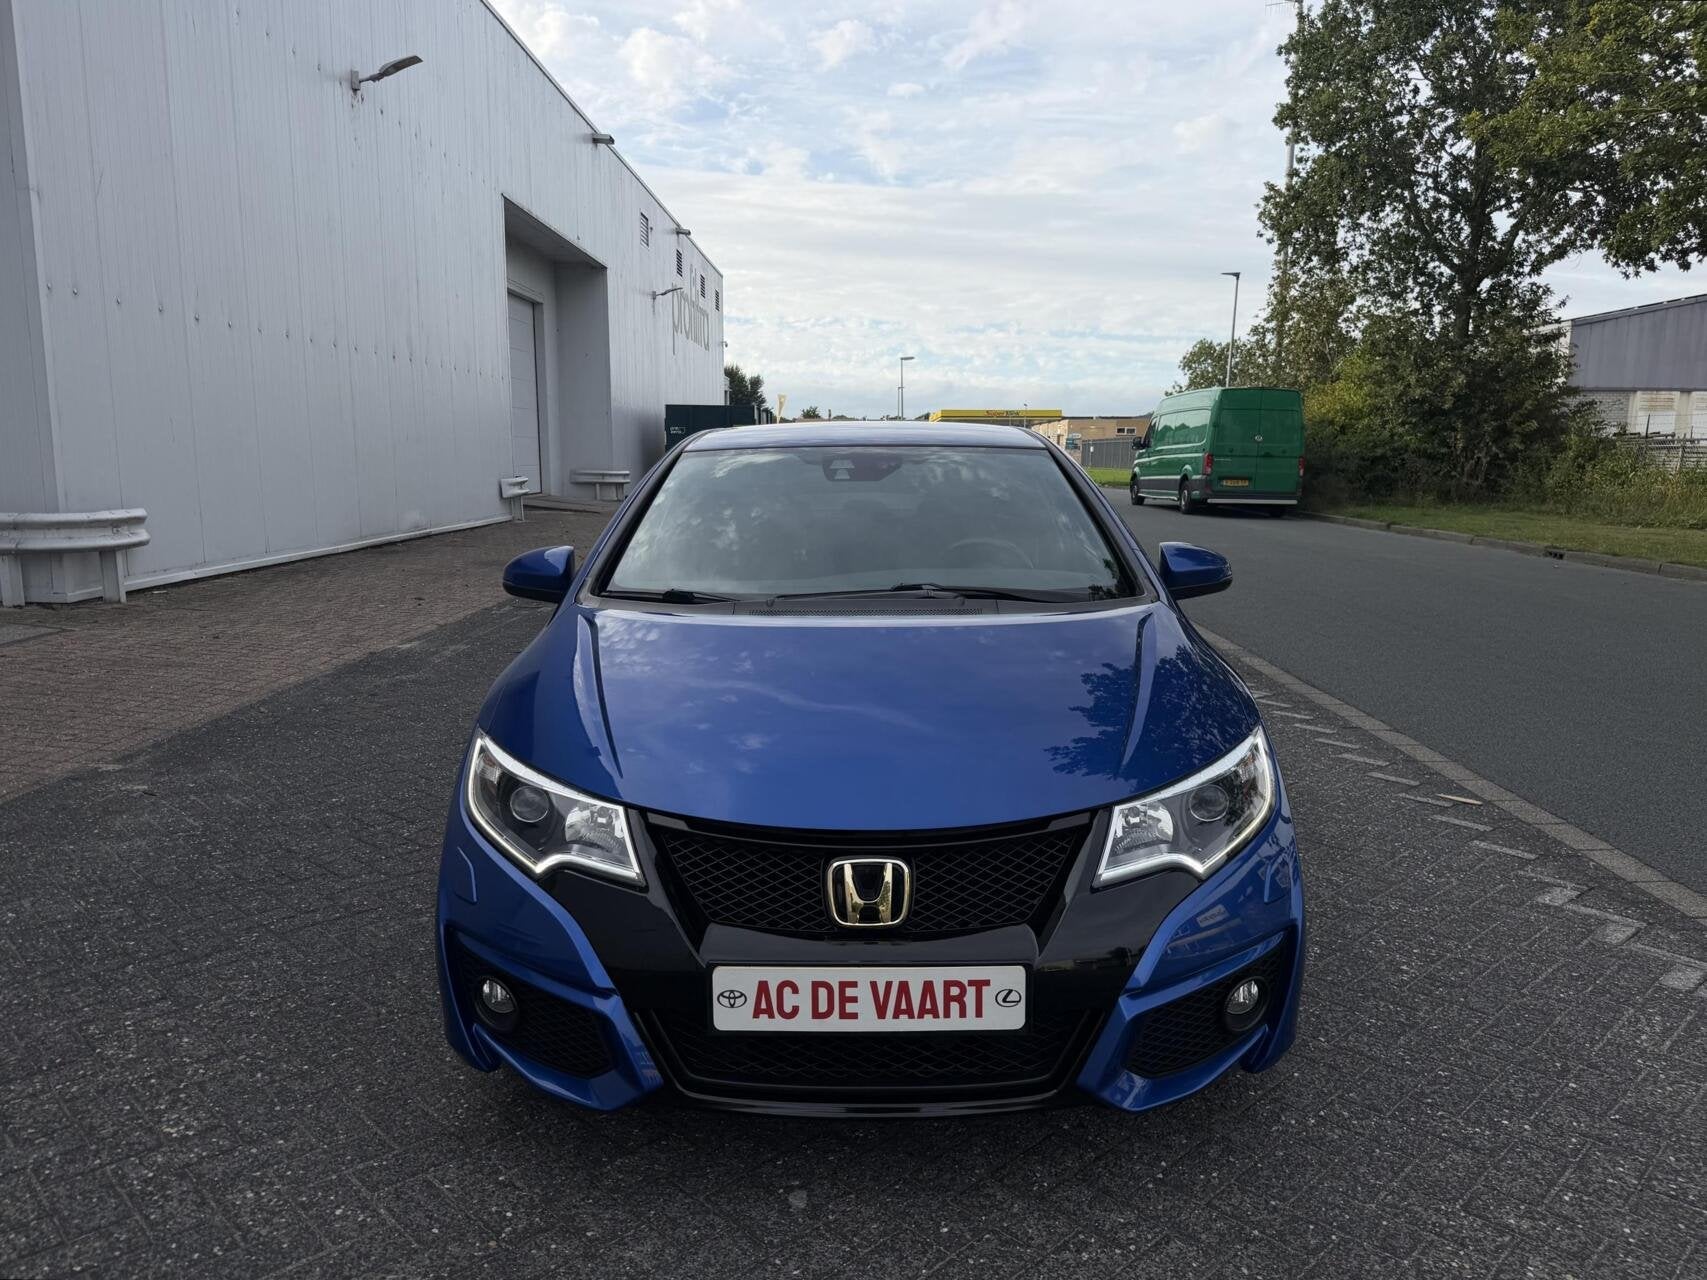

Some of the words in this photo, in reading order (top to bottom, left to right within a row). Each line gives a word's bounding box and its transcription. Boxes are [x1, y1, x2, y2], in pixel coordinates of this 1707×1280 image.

[752, 979, 800, 1020] AC
[811, 980, 859, 1020] DE
[870, 978, 991, 1020] VAART
